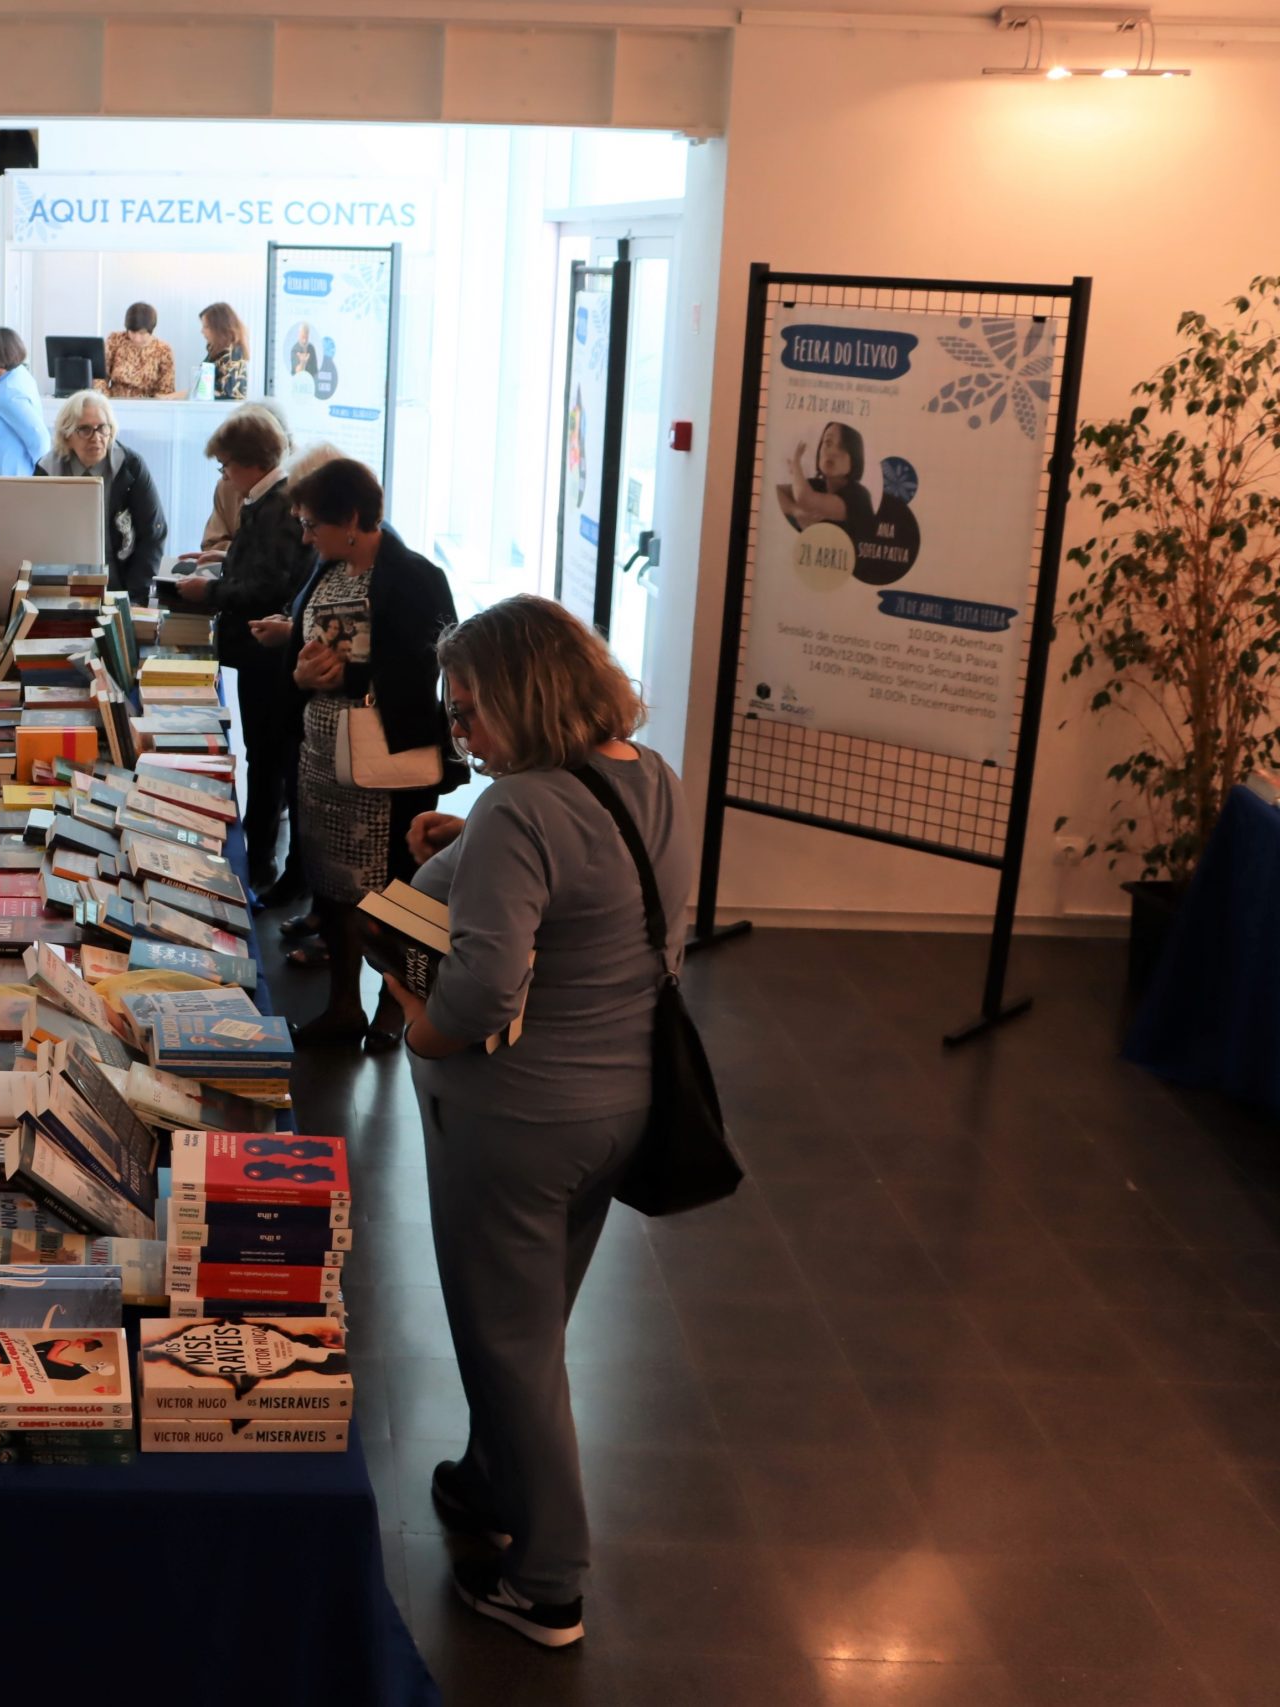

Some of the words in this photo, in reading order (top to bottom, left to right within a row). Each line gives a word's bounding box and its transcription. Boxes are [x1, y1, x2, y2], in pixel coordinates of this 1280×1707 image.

[28, 198, 110, 225] AQUI
[121, 199, 274, 225] FAZEM-SE
[284, 200, 417, 228] CONTAS
[793, 335, 830, 364] FEIRA
[834, 343, 852, 364] DO
[855, 339, 898, 370] LIVRO
[819, 397, 830, 413] DE
[831, 397, 853, 416] ABRIL
[814, 546, 849, 572] ABRIL
[777, 621, 814, 640] Sessão
[816, 627, 830, 642] de
[832, 630, 871, 648] contos
[873, 638, 901, 653] com
[906, 644, 930, 660] Ana
[933, 647, 963, 665] Sofia
[966, 652, 998, 669] Paiva
[951, 632, 1004, 654] Abertura
[910, 693, 996, 719] Encerramento
[259, 1234, 274, 1242] ilha
[251, 1327, 270, 1346] HUGO
[165, 1342, 181, 1353] OS
[183, 1334, 215, 1366] MISE
[254, 1345, 273, 1374] VICTOR
[16, 1405, 49, 1413] CRIMES
[58, 1404, 104, 1414] CORAÇÃO
[156, 1397, 193, 1409] VICTOR
[198, 1398, 227, 1409] HUGO
[247, 1399, 257, 1407] OS
[259, 1395, 330, 1409] MISERÁVEIS
[17, 1420, 50, 1428] CRIMES
[59, 1419, 105, 1429] CORAÇÃO
[153, 1431, 190, 1443] VICTOR
[194, 1431, 224, 1443] HUGO
[244, 1432, 254, 1440] OS
[255, 1428, 327, 1443] MISERÁVEIS
